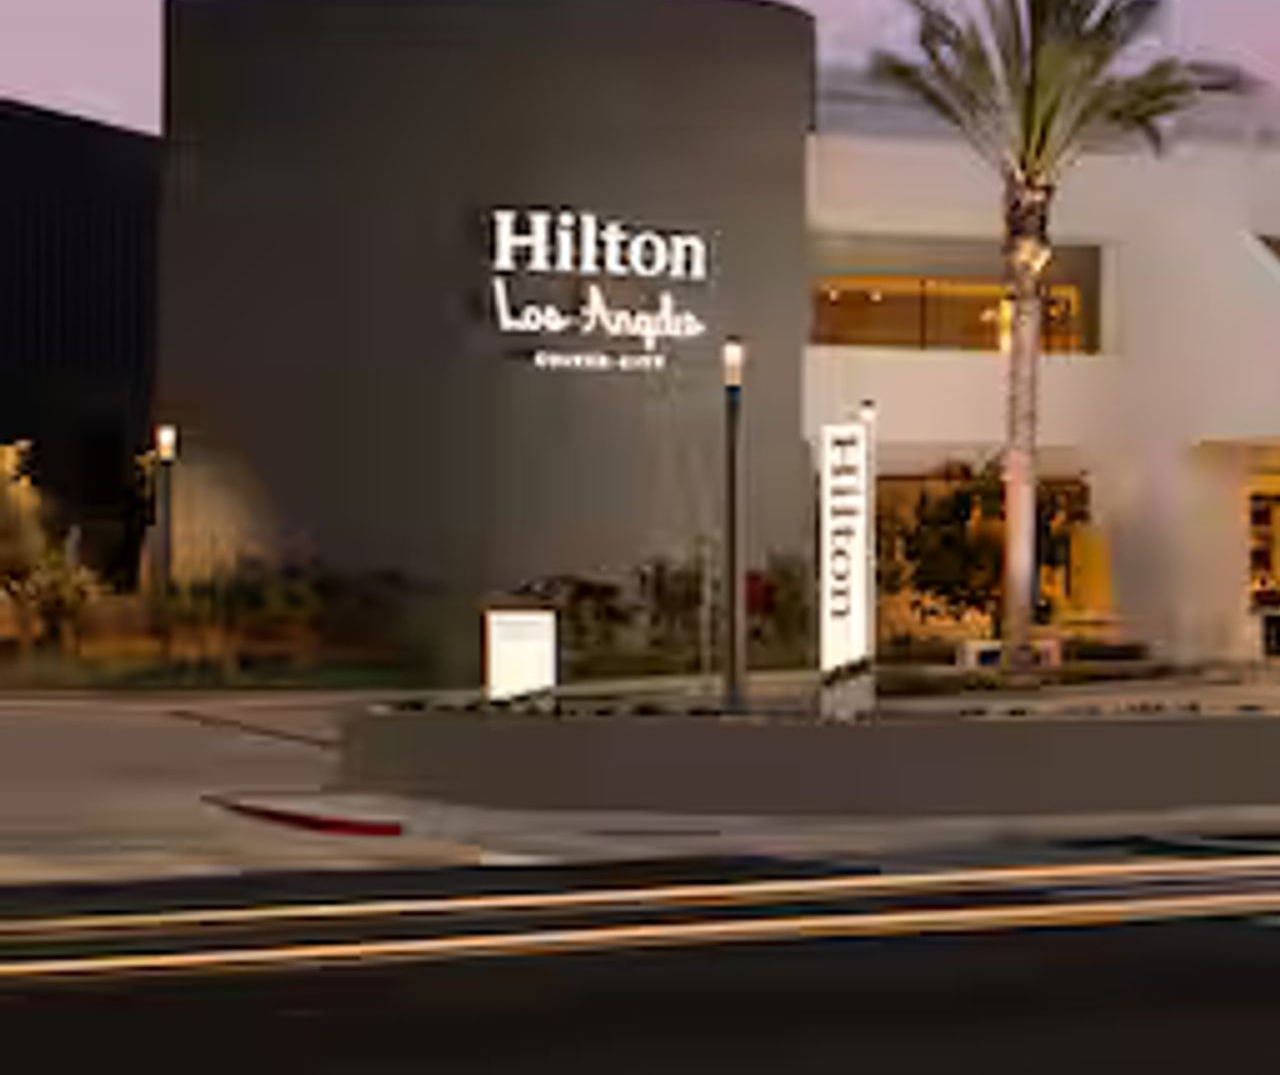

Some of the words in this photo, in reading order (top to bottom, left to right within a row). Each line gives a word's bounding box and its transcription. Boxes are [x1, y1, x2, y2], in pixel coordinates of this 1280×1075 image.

[493, 209, 706, 280] Hilton
[494, 277, 570, 332] Los
[580, 284, 707, 351] Angeles
[831, 437, 859, 617] Hilton
